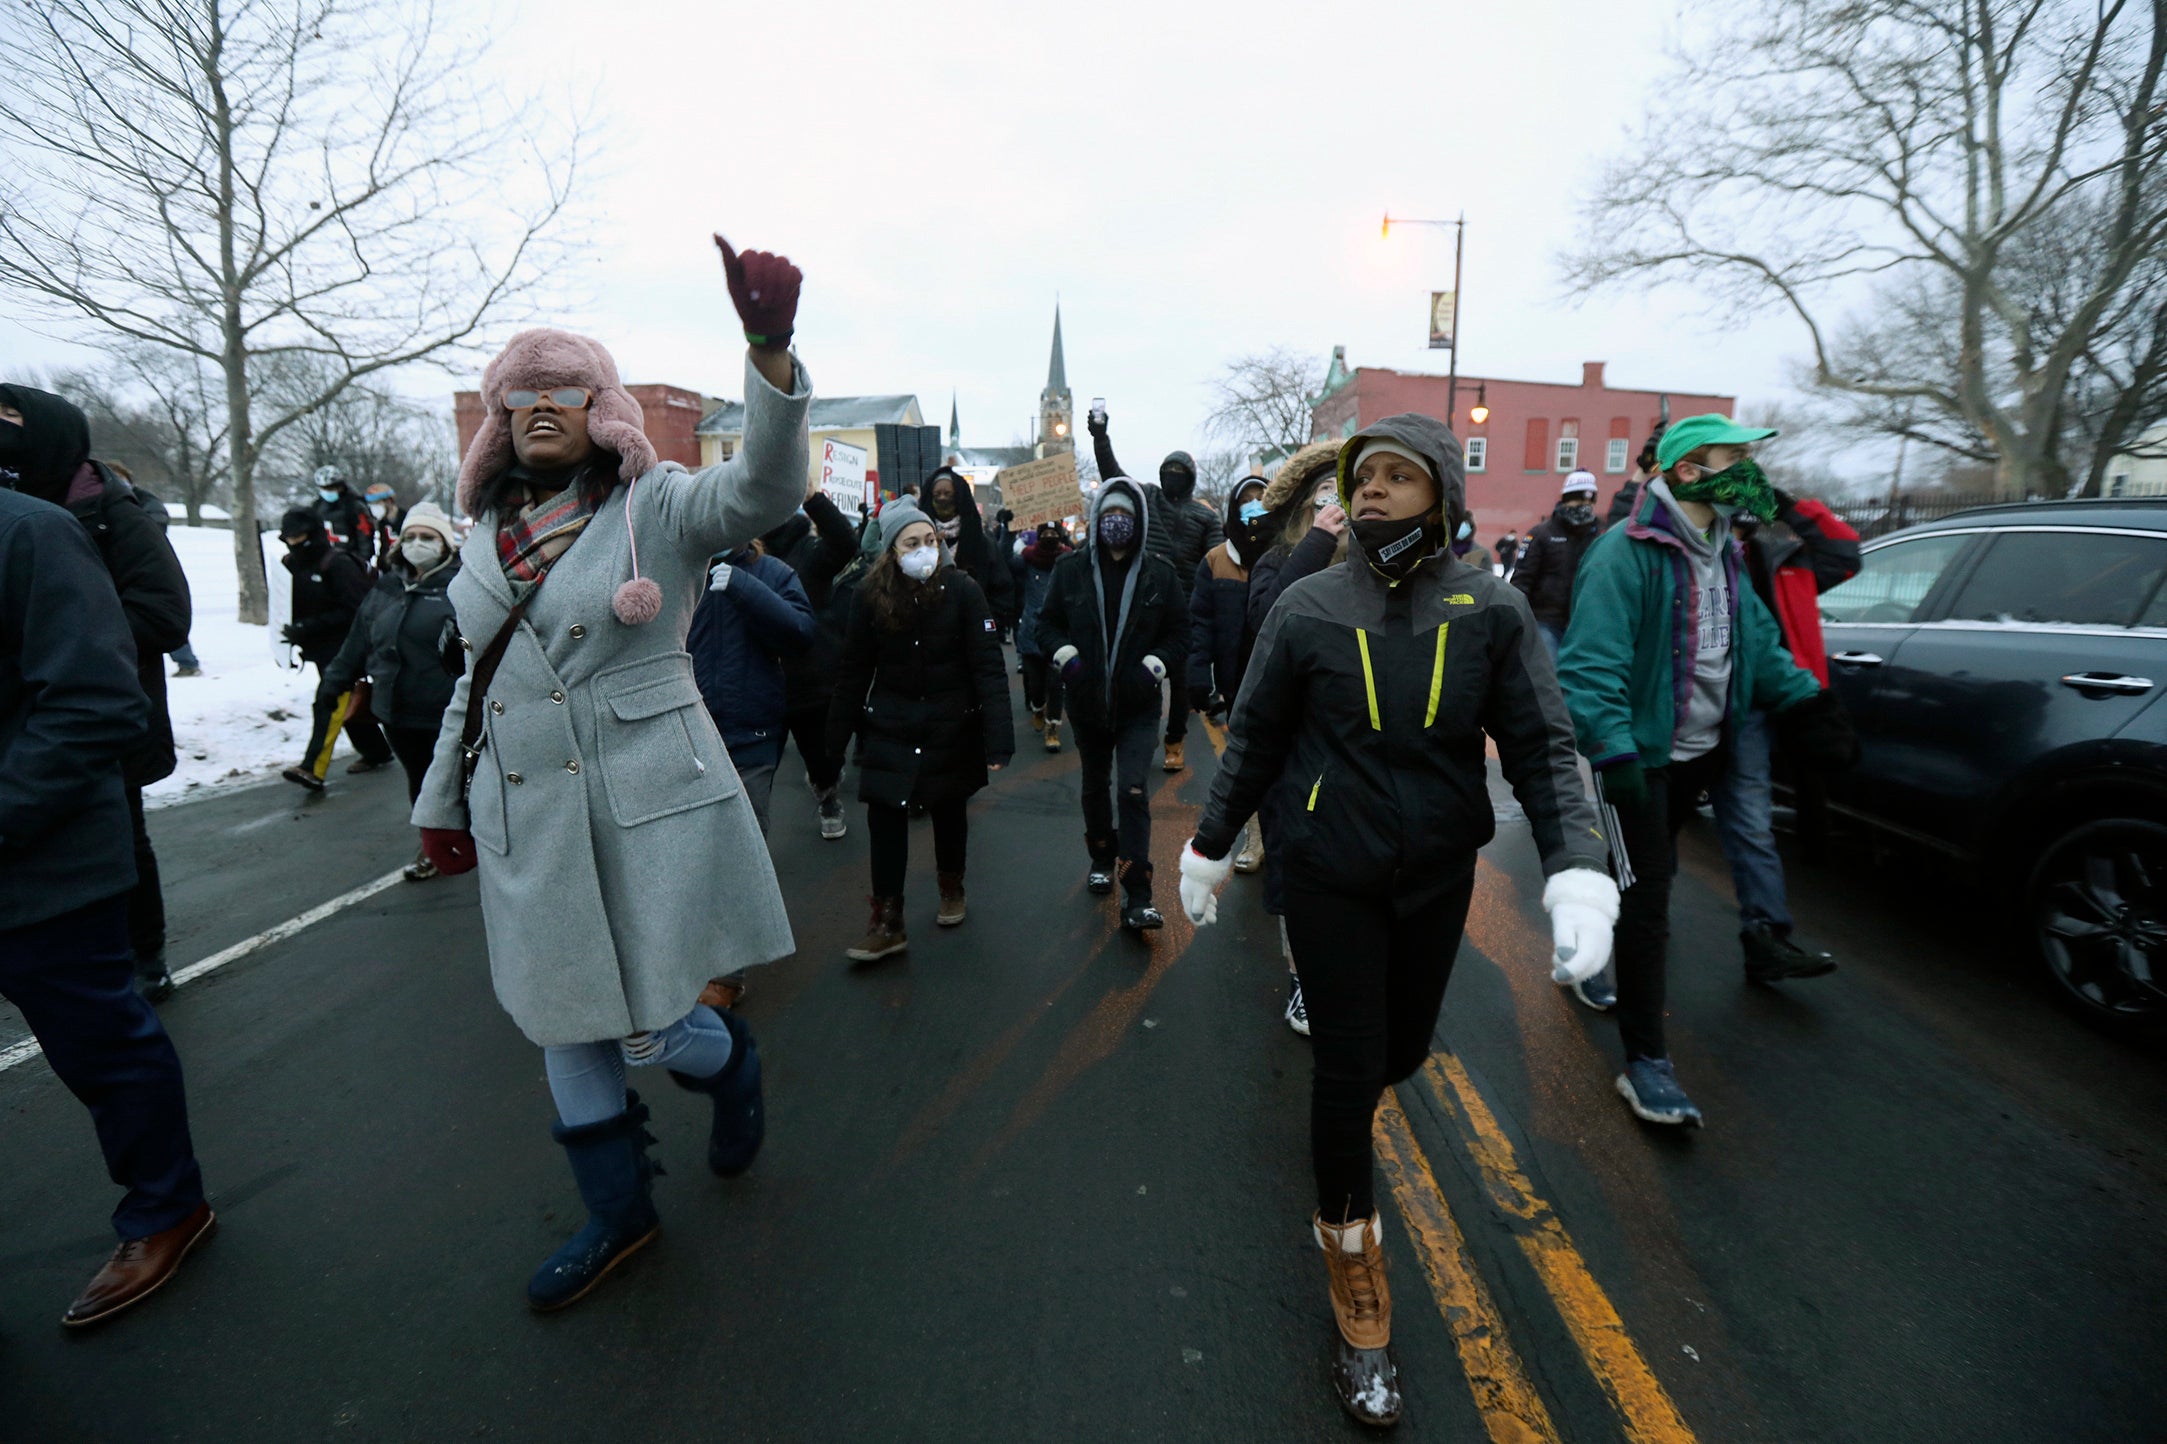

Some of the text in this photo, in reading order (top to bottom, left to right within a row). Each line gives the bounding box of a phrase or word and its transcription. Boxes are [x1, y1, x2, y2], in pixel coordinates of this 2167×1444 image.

[1012, 470, 1077, 497] HELP PEOPLE
[1064, 503, 1083, 515] GUN
